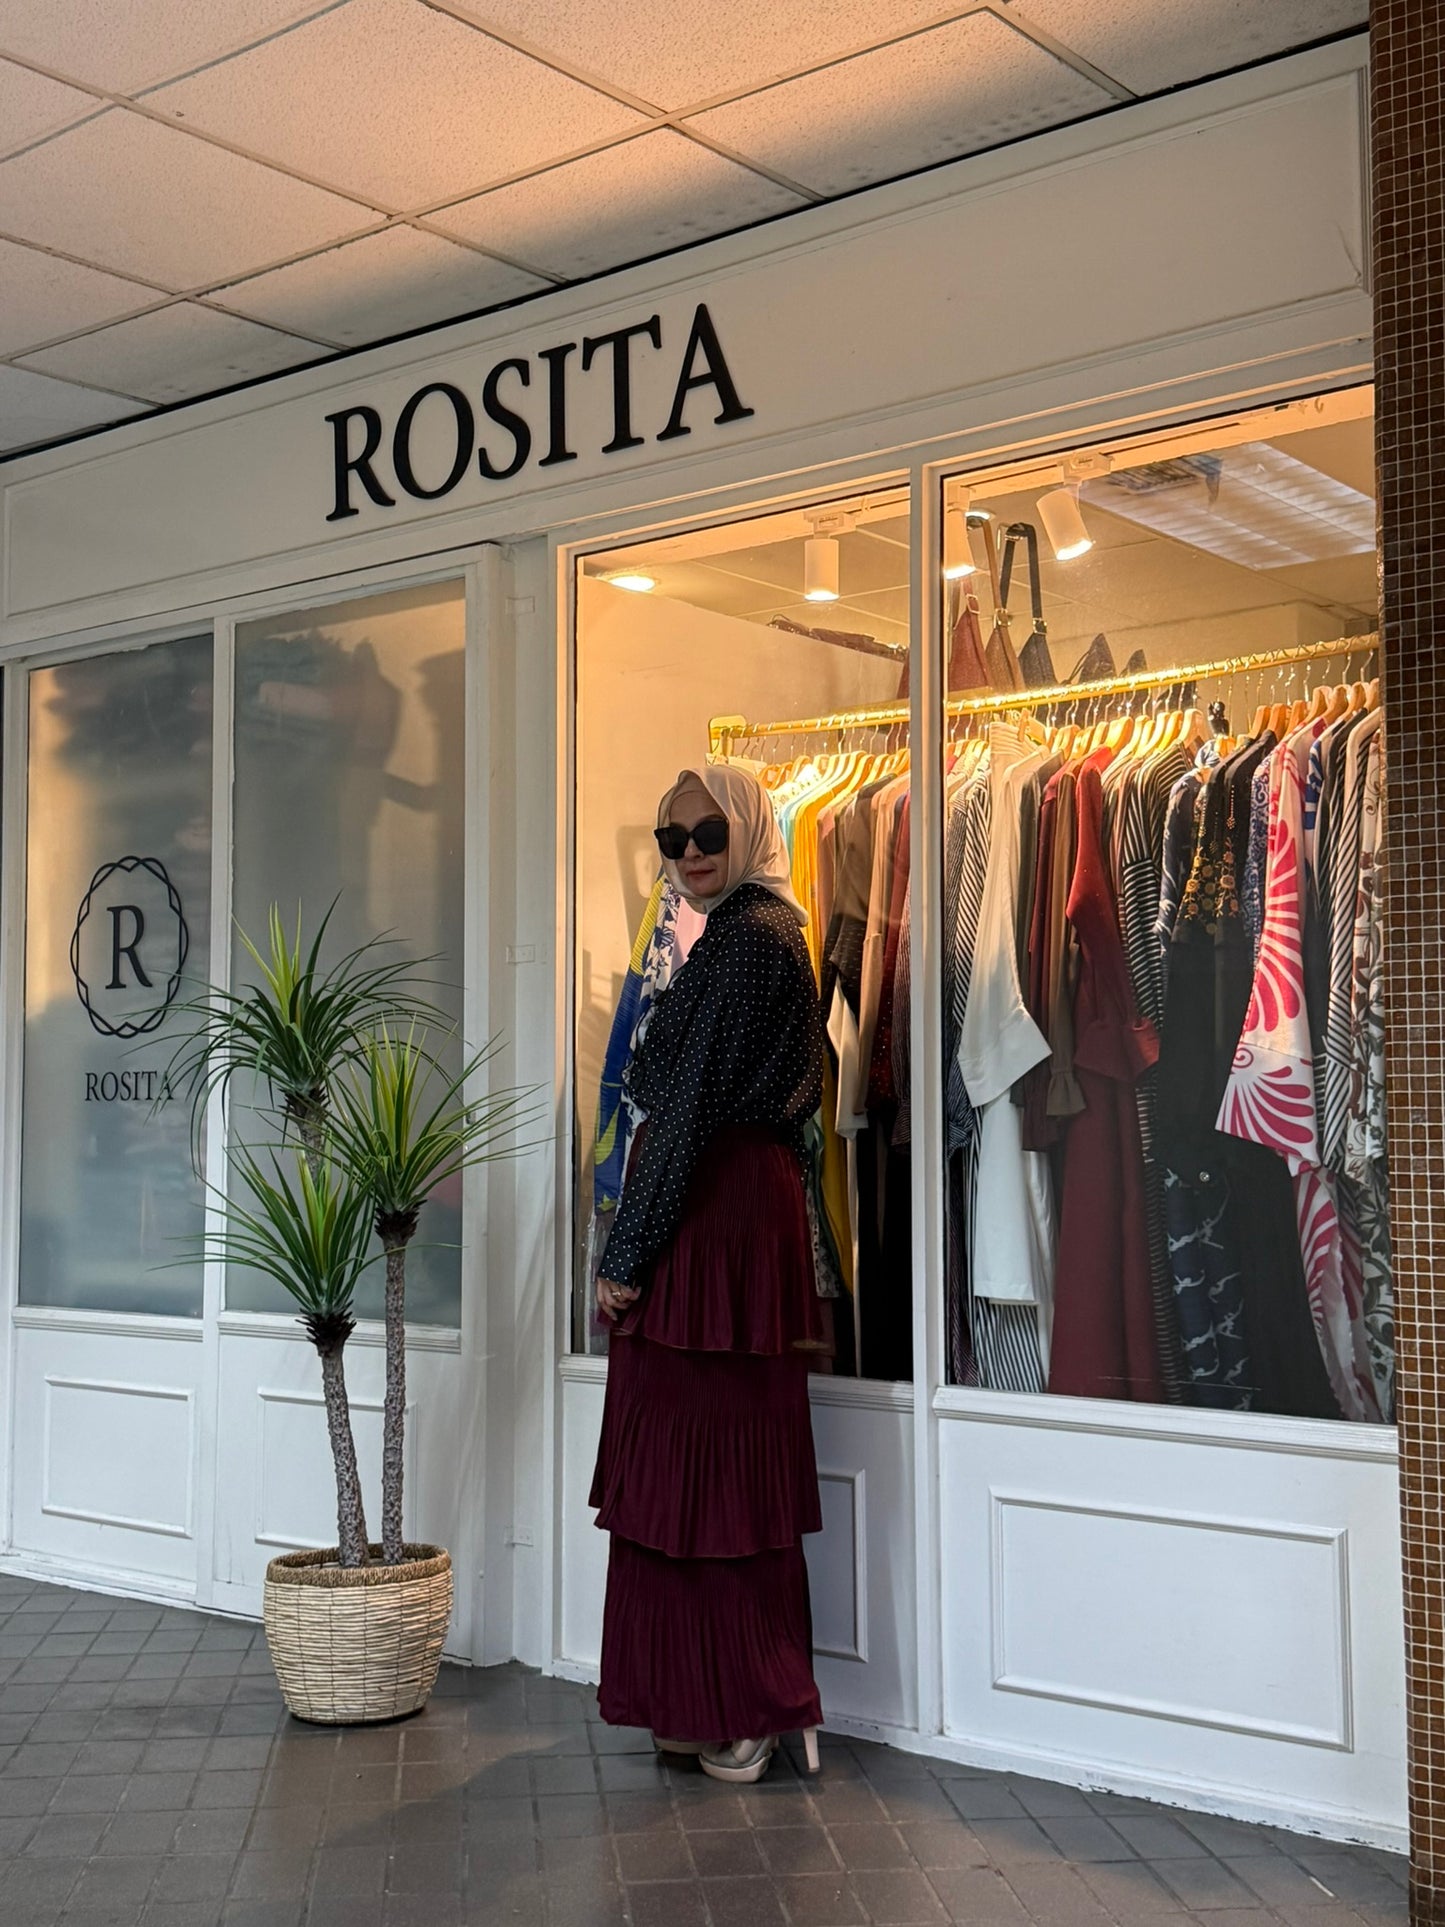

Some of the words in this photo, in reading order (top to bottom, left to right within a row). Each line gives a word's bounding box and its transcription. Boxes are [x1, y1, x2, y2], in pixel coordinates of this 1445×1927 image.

[325, 303, 754, 521] ROSITA
[105, 905, 153, 989] R
[85, 1071, 174, 1101] ROSITA
